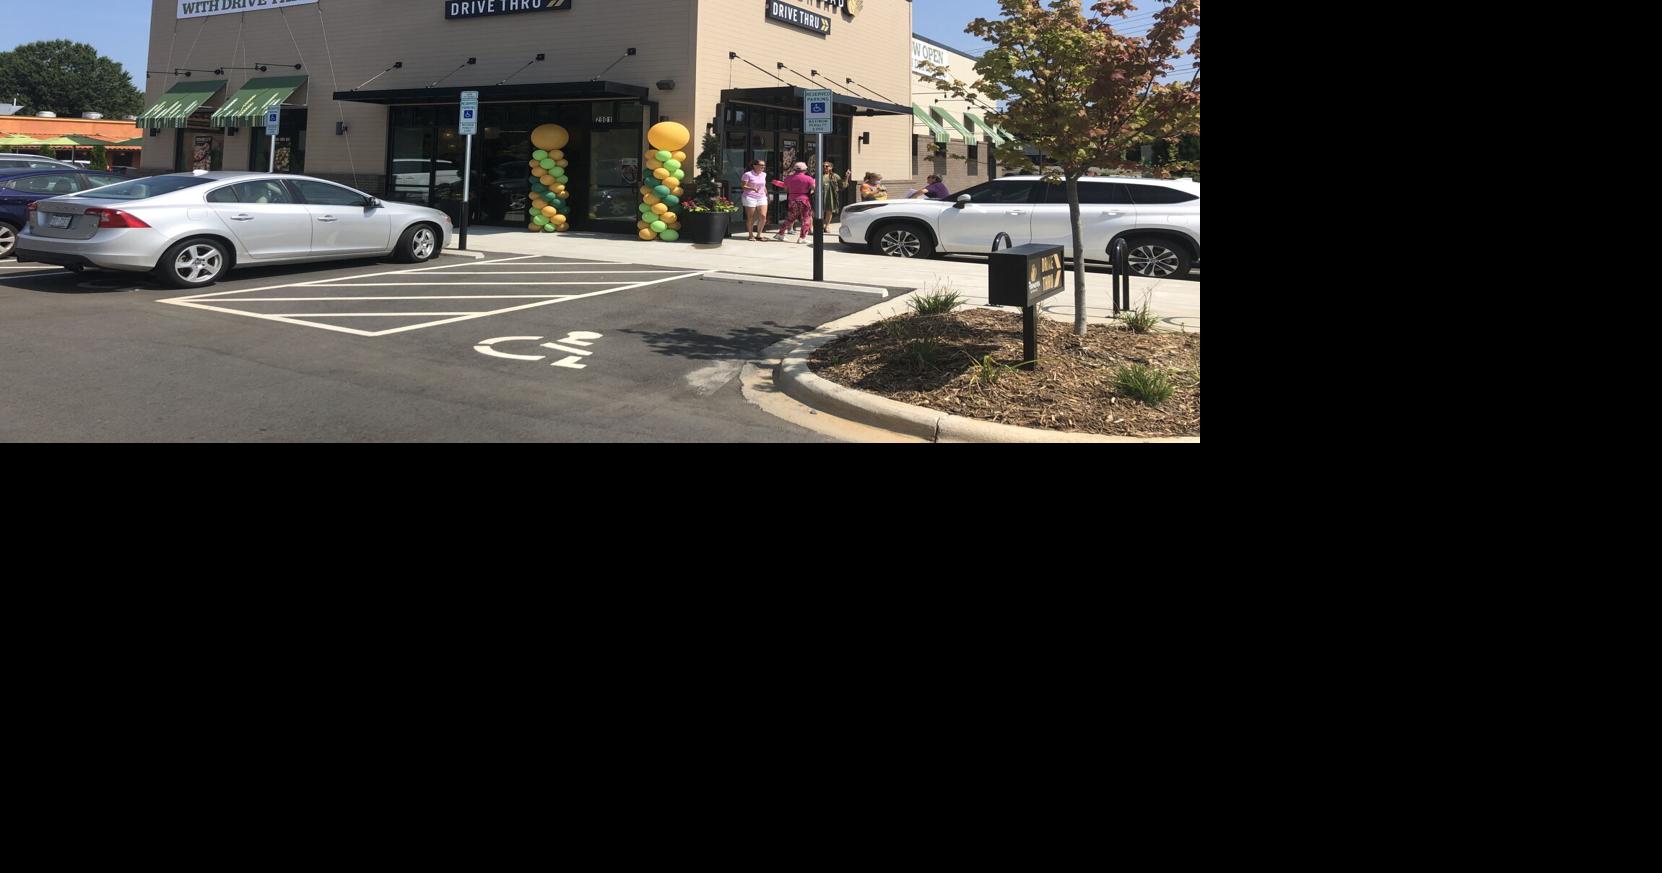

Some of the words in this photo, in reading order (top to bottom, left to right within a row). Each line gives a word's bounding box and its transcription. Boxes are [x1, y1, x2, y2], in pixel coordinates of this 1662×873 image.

[182, 0, 219, 14] WITH
[451, 0, 495, 15] DRIVE
[772, 2, 798, 22] DRIVE
[800, 11, 820, 29] THRU
[922, 45, 944, 64] OPEN
